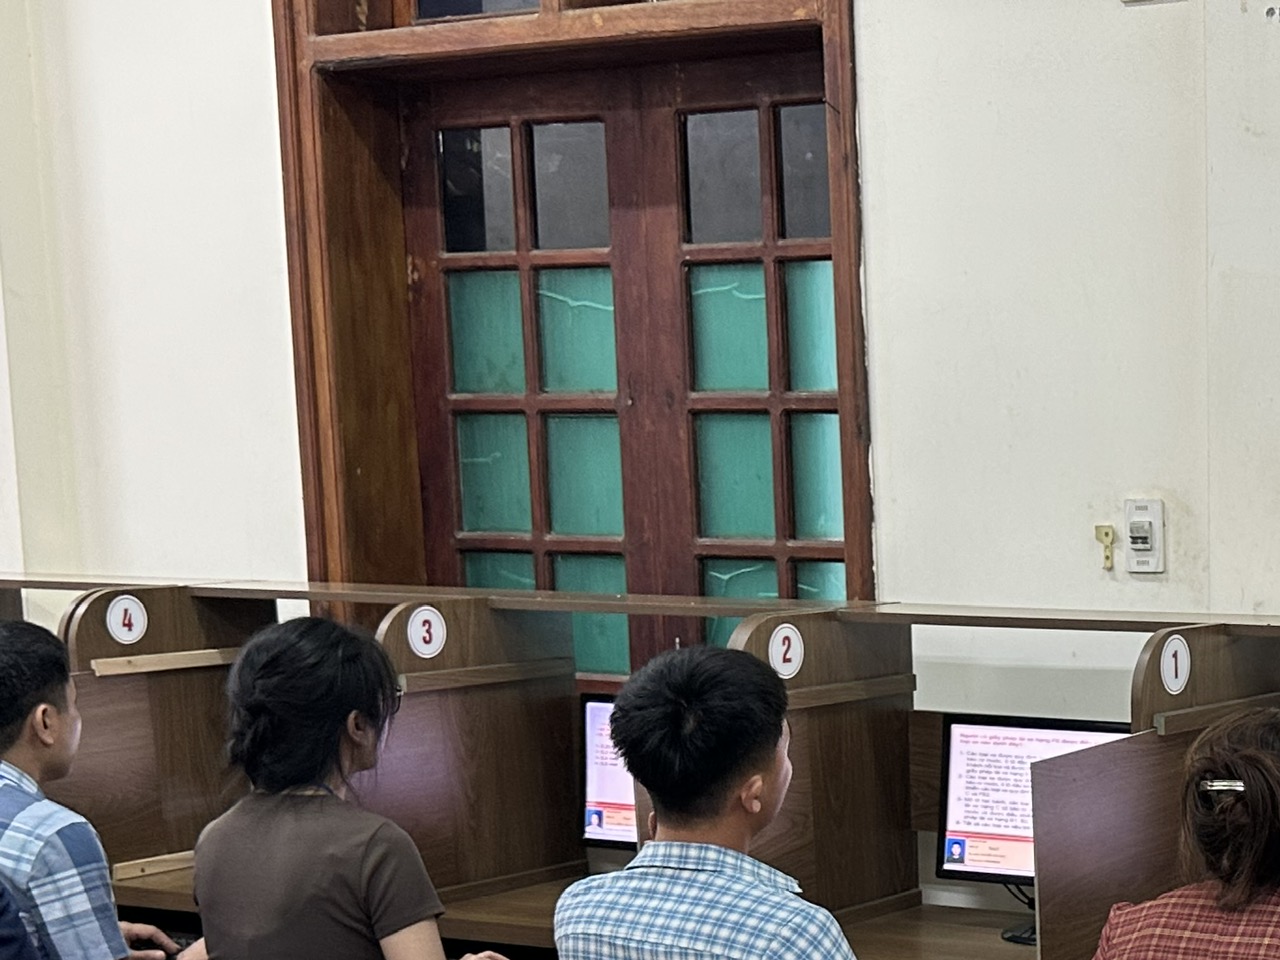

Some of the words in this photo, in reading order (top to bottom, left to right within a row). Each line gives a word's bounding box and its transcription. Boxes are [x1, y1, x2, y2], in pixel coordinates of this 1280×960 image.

[122, 608, 134, 632] 4
[422, 619, 433, 645] 3
[782, 635, 792, 663] 2
[1172, 650, 1178, 679] 1
